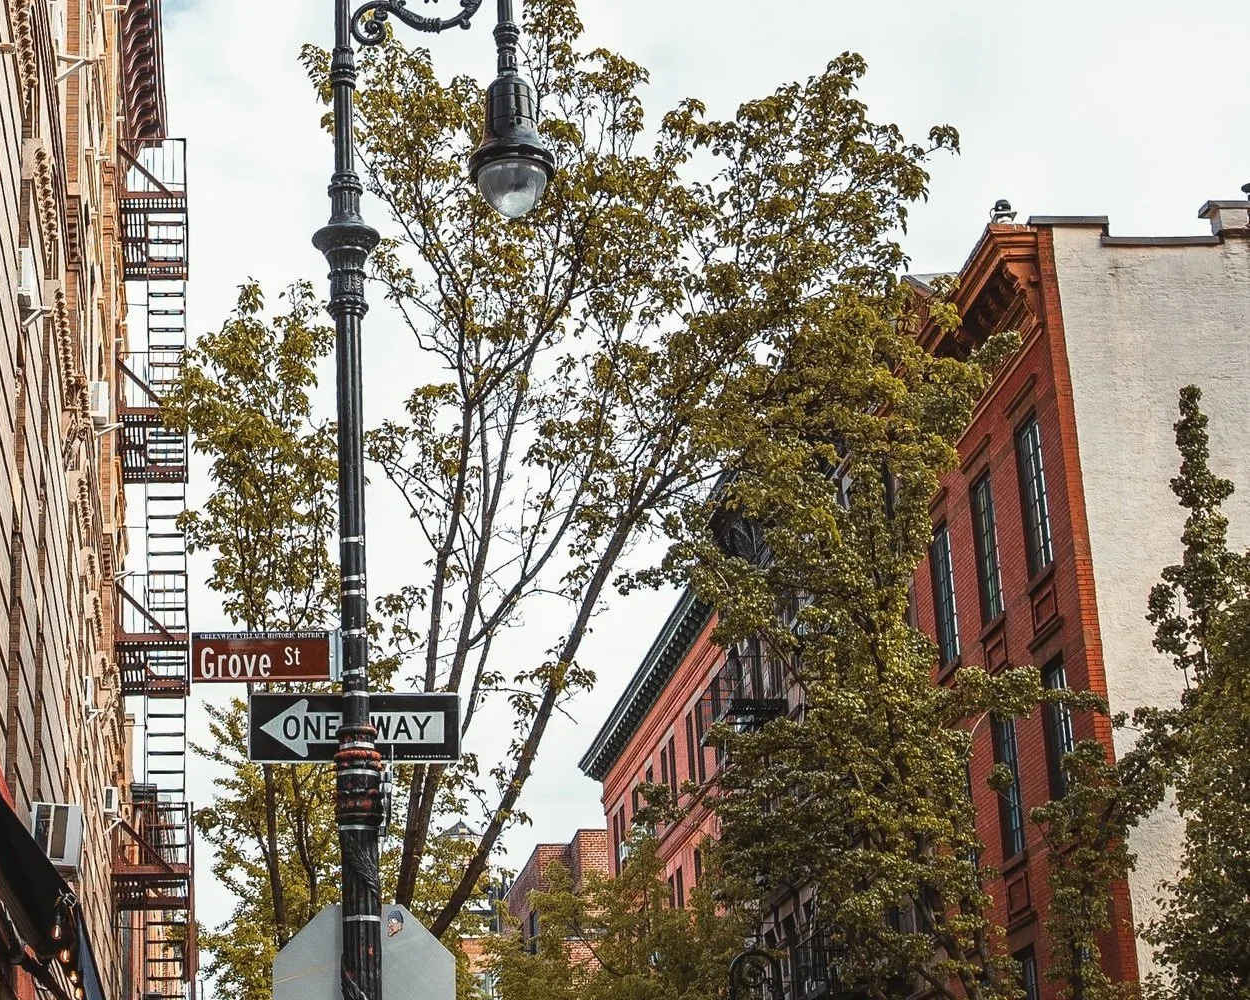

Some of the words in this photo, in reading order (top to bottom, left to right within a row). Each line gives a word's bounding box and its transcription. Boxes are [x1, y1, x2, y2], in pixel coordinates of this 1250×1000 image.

[298, 631, 326, 639] DISTRICT
[200, 646, 272, 679] Grove
[284, 646, 301, 666] St
[282, 715, 340, 741] ONE
[370, 715, 432, 741] WAY
